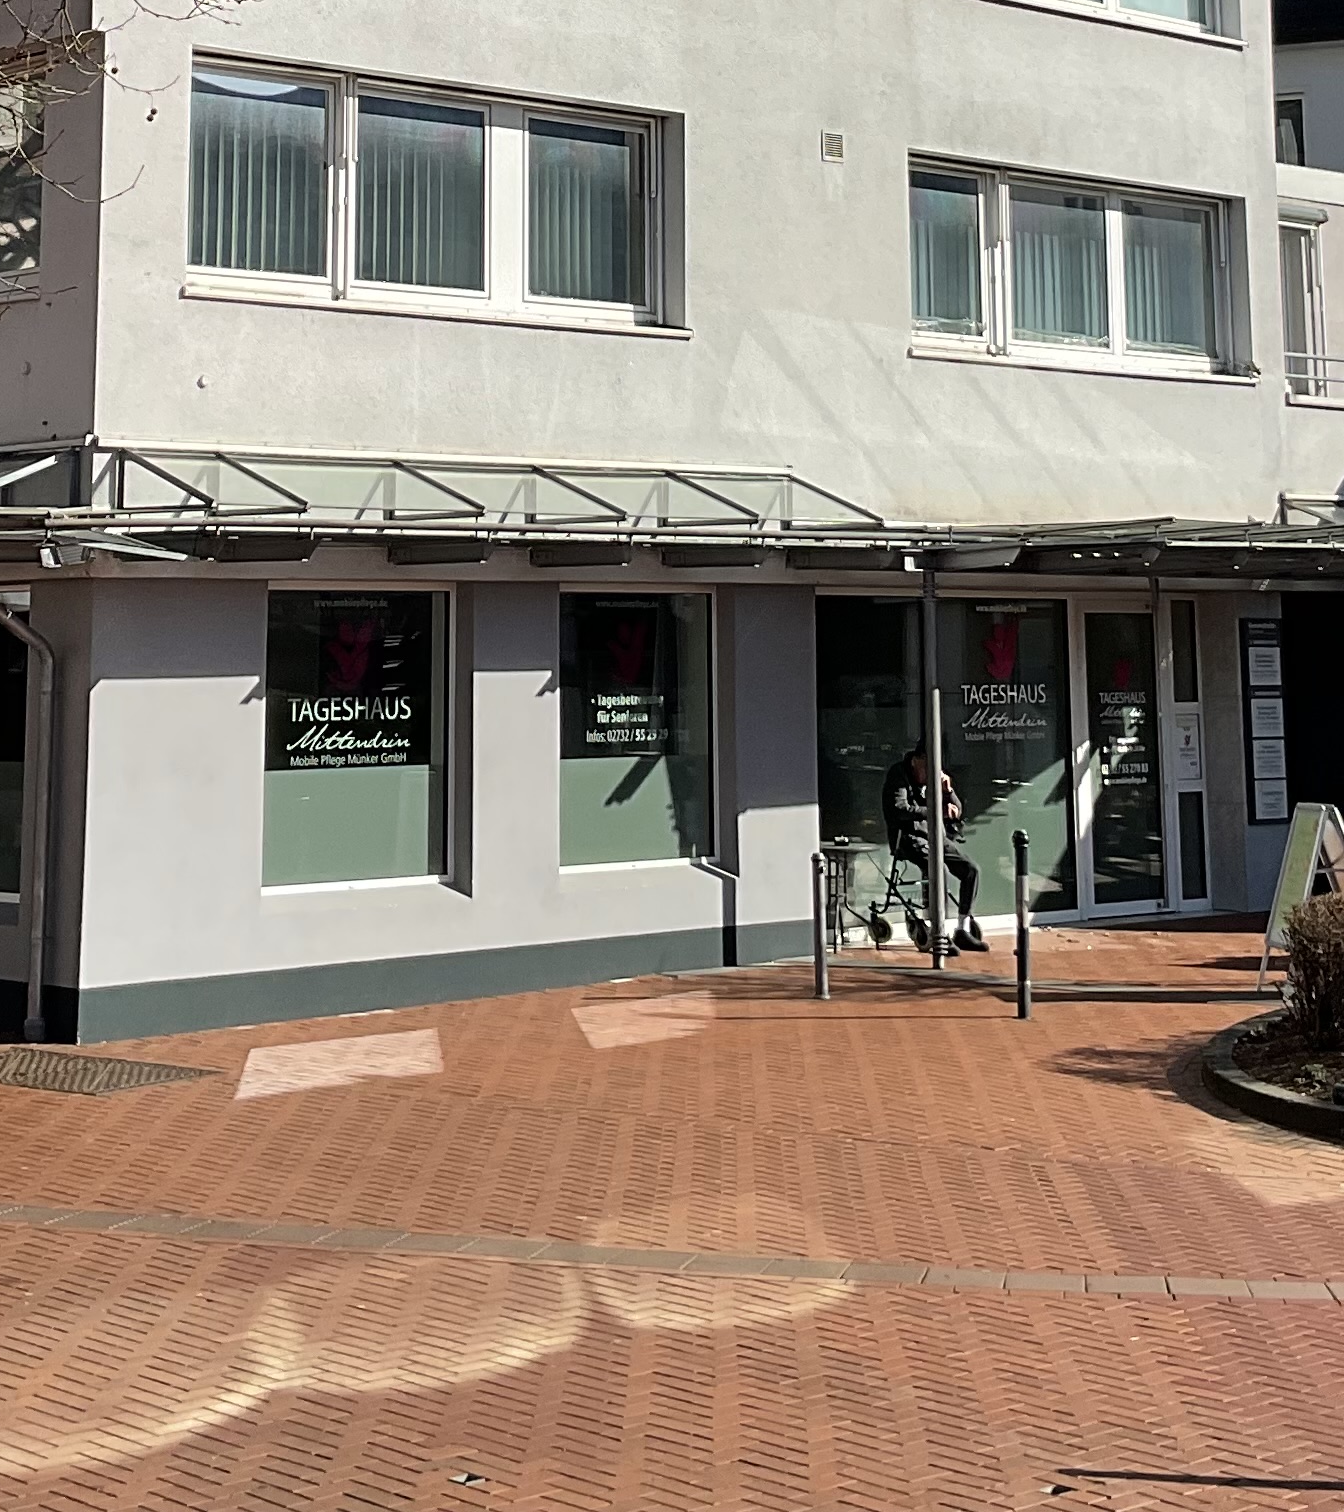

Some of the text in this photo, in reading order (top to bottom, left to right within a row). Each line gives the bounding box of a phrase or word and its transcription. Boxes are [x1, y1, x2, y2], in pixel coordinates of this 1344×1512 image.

[960, 683, 1047, 705] TAGESHAUS
[1099, 691, 1146, 704] TAGESHAUS
[287, 695, 412, 722] TAGESHAUS
[596, 709, 649, 724] für Senioren
[286, 723, 411, 751] Mittendrin
[607, 728, 629, 742] 02732
[290, 751, 407, 767] Mobile Pflege Münker GmbH
